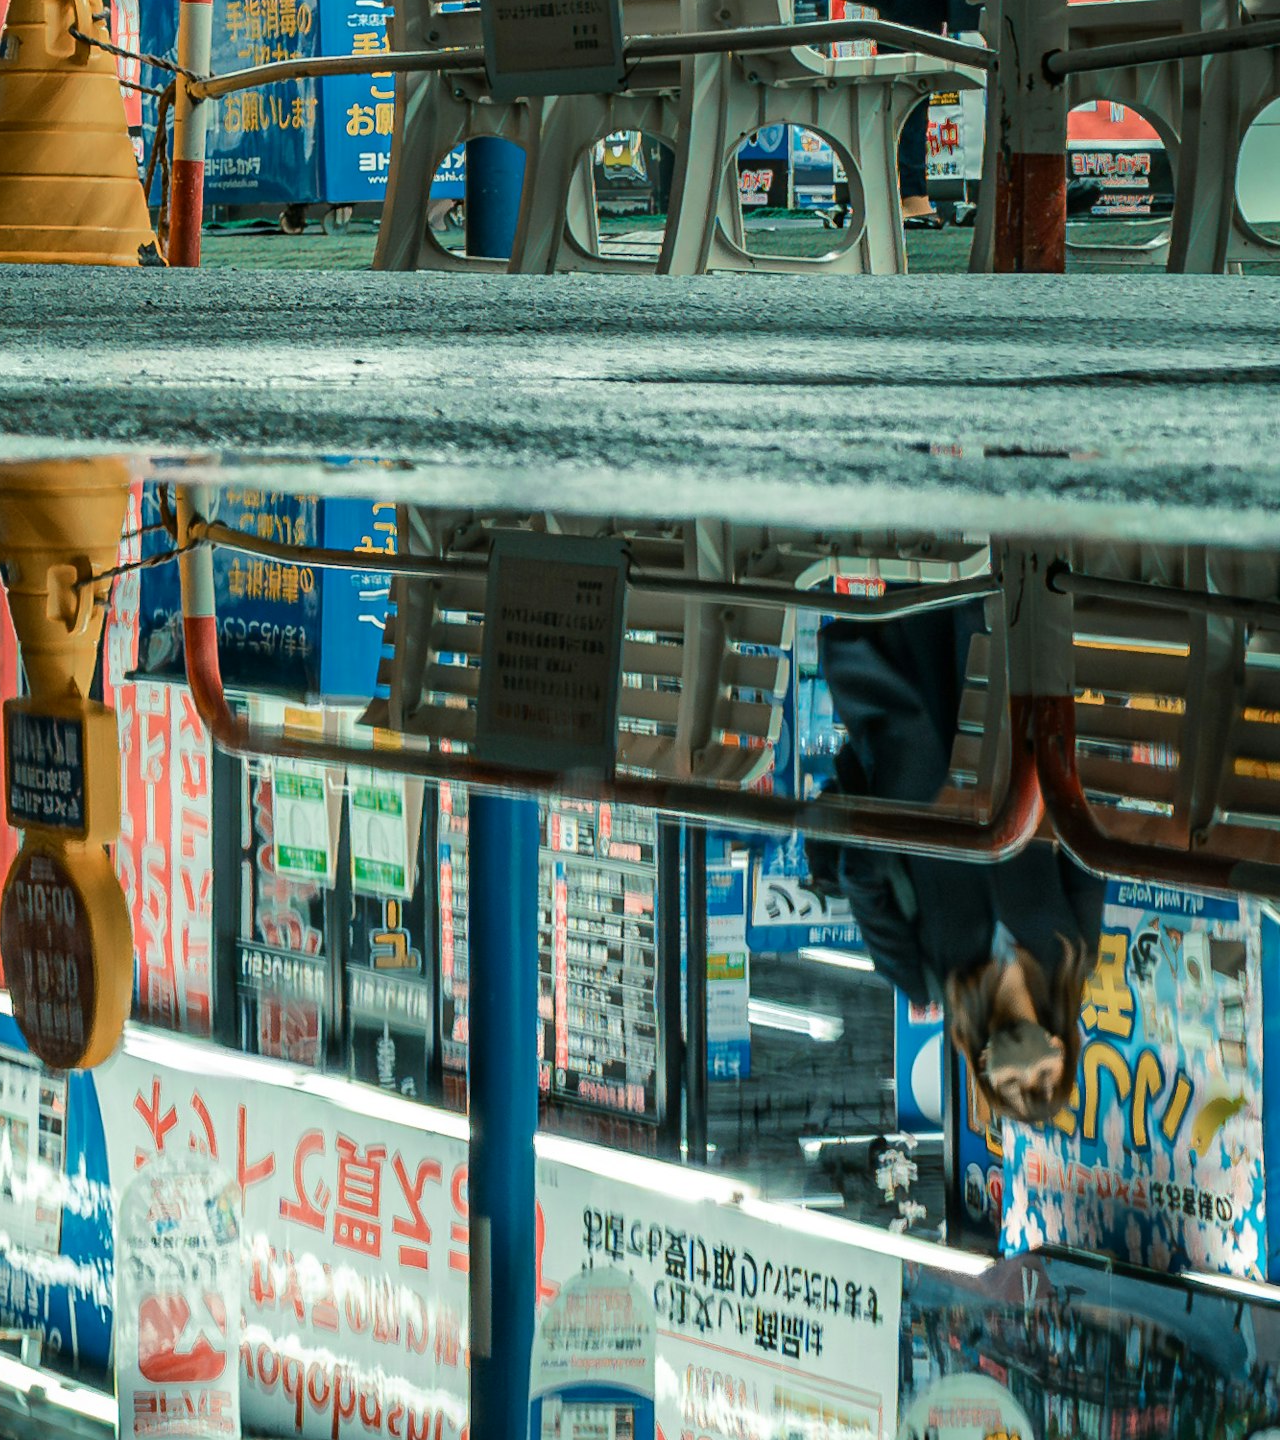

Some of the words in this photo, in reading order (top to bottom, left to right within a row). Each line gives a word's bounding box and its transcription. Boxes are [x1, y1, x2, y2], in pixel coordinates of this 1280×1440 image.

[222, 92, 319, 134] お願いします
[1072, 154, 1152, 177] ヨドバシカメラ
